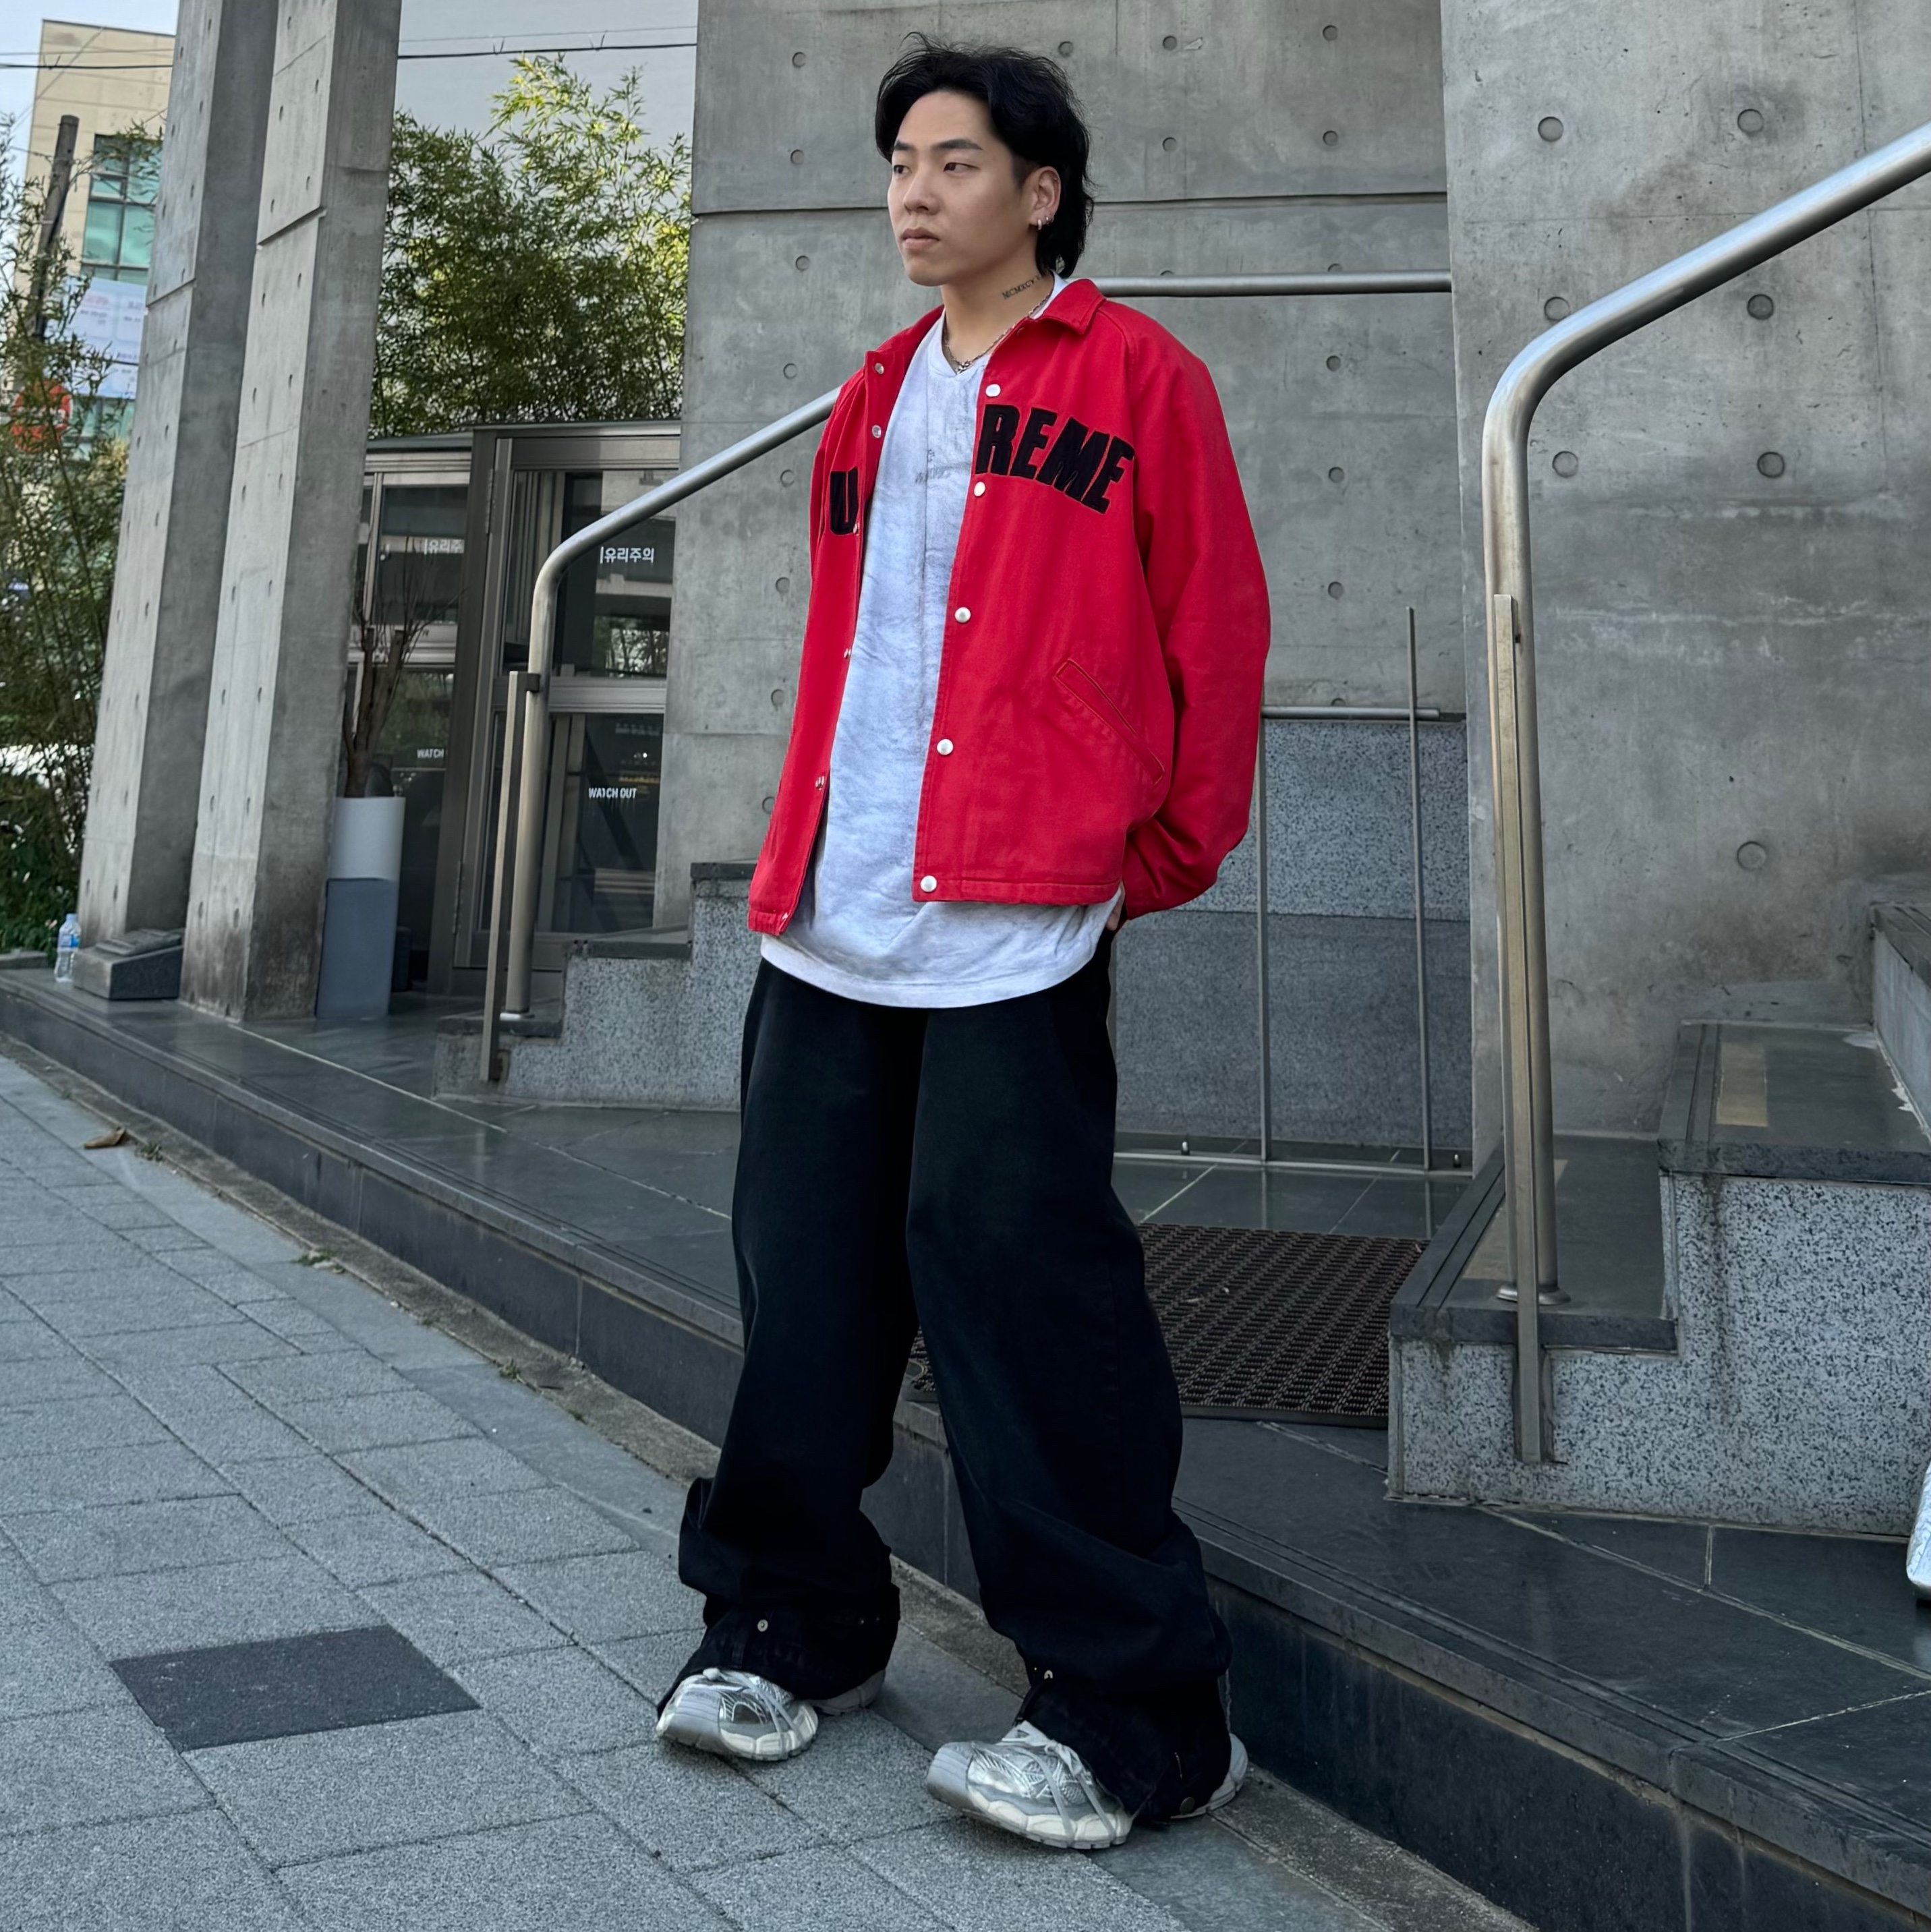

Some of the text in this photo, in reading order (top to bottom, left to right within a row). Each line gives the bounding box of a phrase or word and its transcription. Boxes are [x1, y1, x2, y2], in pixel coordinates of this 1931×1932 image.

[604, 547, 654, 563] 유리주의
[417, 748, 444, 759] WATCH
[588, 787, 637, 798] WATCH OUT
